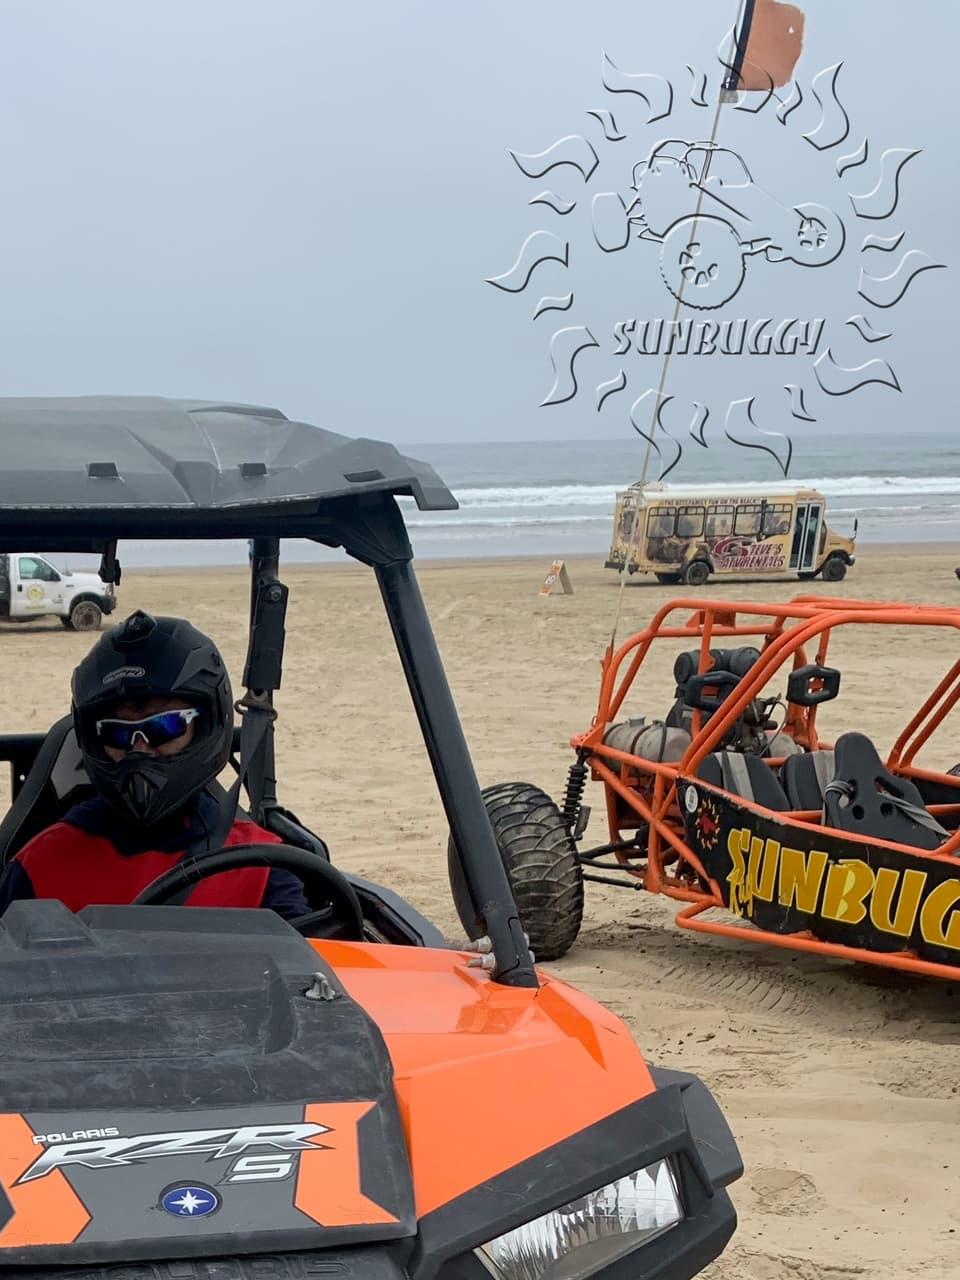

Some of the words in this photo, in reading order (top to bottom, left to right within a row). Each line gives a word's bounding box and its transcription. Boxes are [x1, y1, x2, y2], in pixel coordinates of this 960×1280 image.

[32, 1127, 120, 1145] POLARIS
[12, 1122, 333, 1187] RZR
[223, 1152, 296, 1185] S
